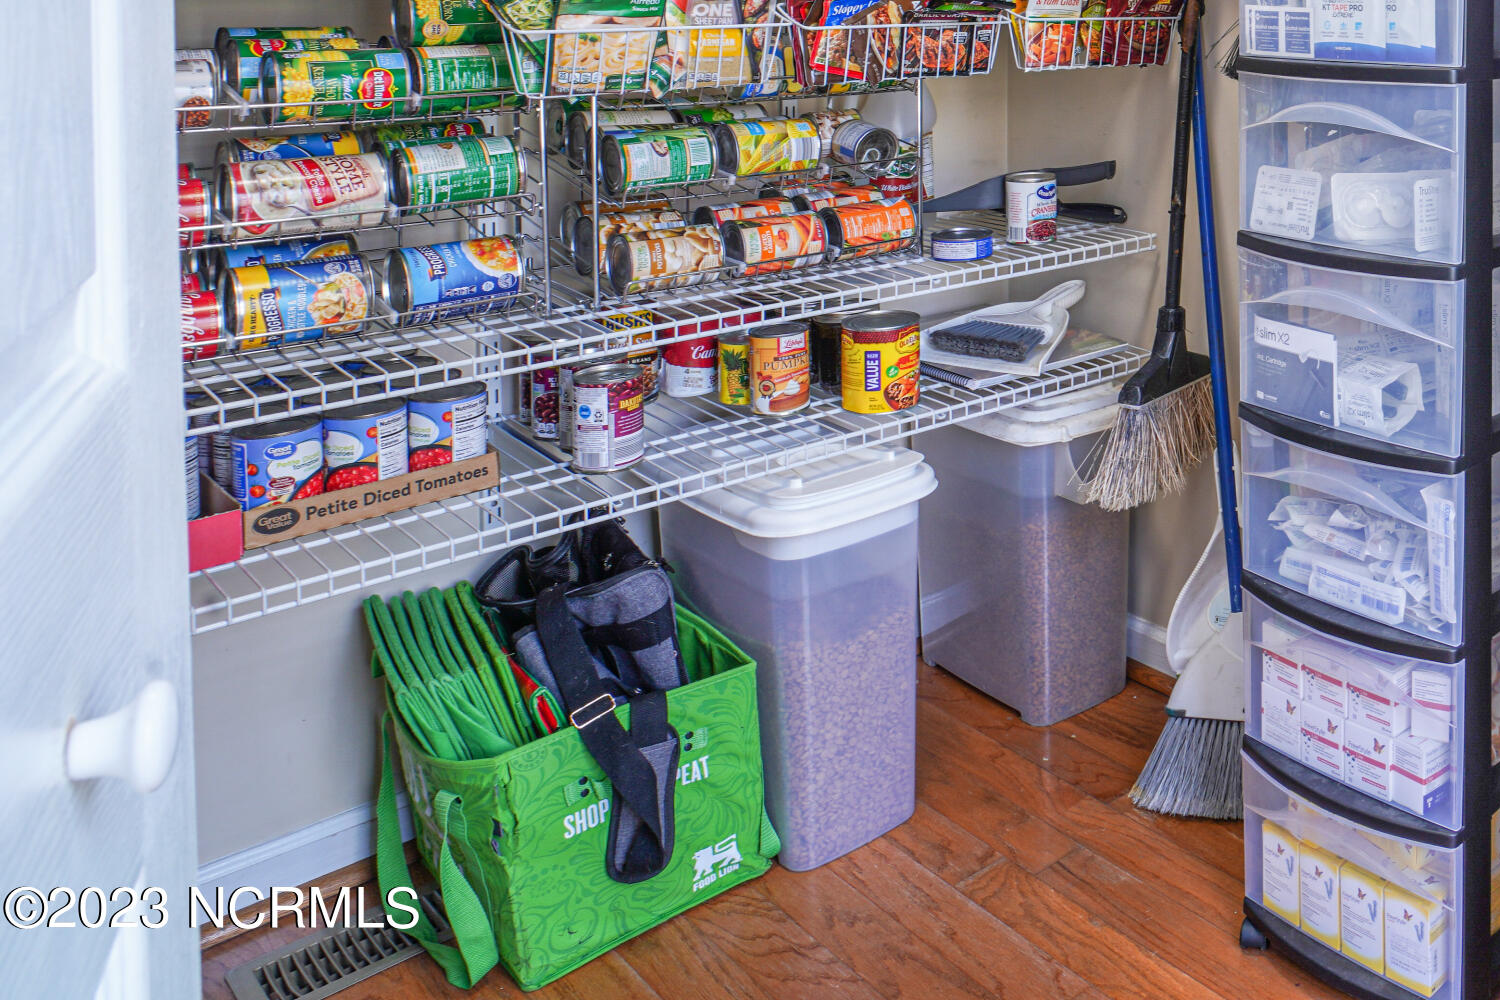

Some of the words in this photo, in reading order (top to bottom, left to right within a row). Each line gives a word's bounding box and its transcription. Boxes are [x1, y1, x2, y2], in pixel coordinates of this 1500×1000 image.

[691, 3, 734, 17] ONE
[832, 3, 865, 17] Sloppy
[1322, 4, 1331, 12] KT
[695, 17, 717, 26] SHEET
[718, 17, 734, 25] PAN
[311, 65, 329, 96] KERNEL
[324, 77, 338, 102] WHOL
[319, 156, 351, 195] STYLE
[340, 156, 366, 192] HOME
[655, 242, 665, 270] POTATOES
[264, 293, 283, 342] POGRESSO
[783, 337, 804, 349] Libby's
[1278, 332, 1291, 346] X2
[763, 358, 810, 371] PUMPKI
[866, 359, 880, 390] VALUE
[455, 402, 478, 412] Nutrition
[267, 443, 292, 455] Great
[292, 456, 321, 470] Tomatoes
[305, 498, 358, 521] Petite
[363, 483, 411, 507] Diced
[415, 464, 489, 493] Tomatoes
[257, 512, 292, 528] Great
[266, 519, 294, 531] Value
[675, 755, 710, 787] EAT
[563, 798, 609, 840] SHOP
[692, 871, 717, 893] FOOD
[717, 861, 741, 879] LION
